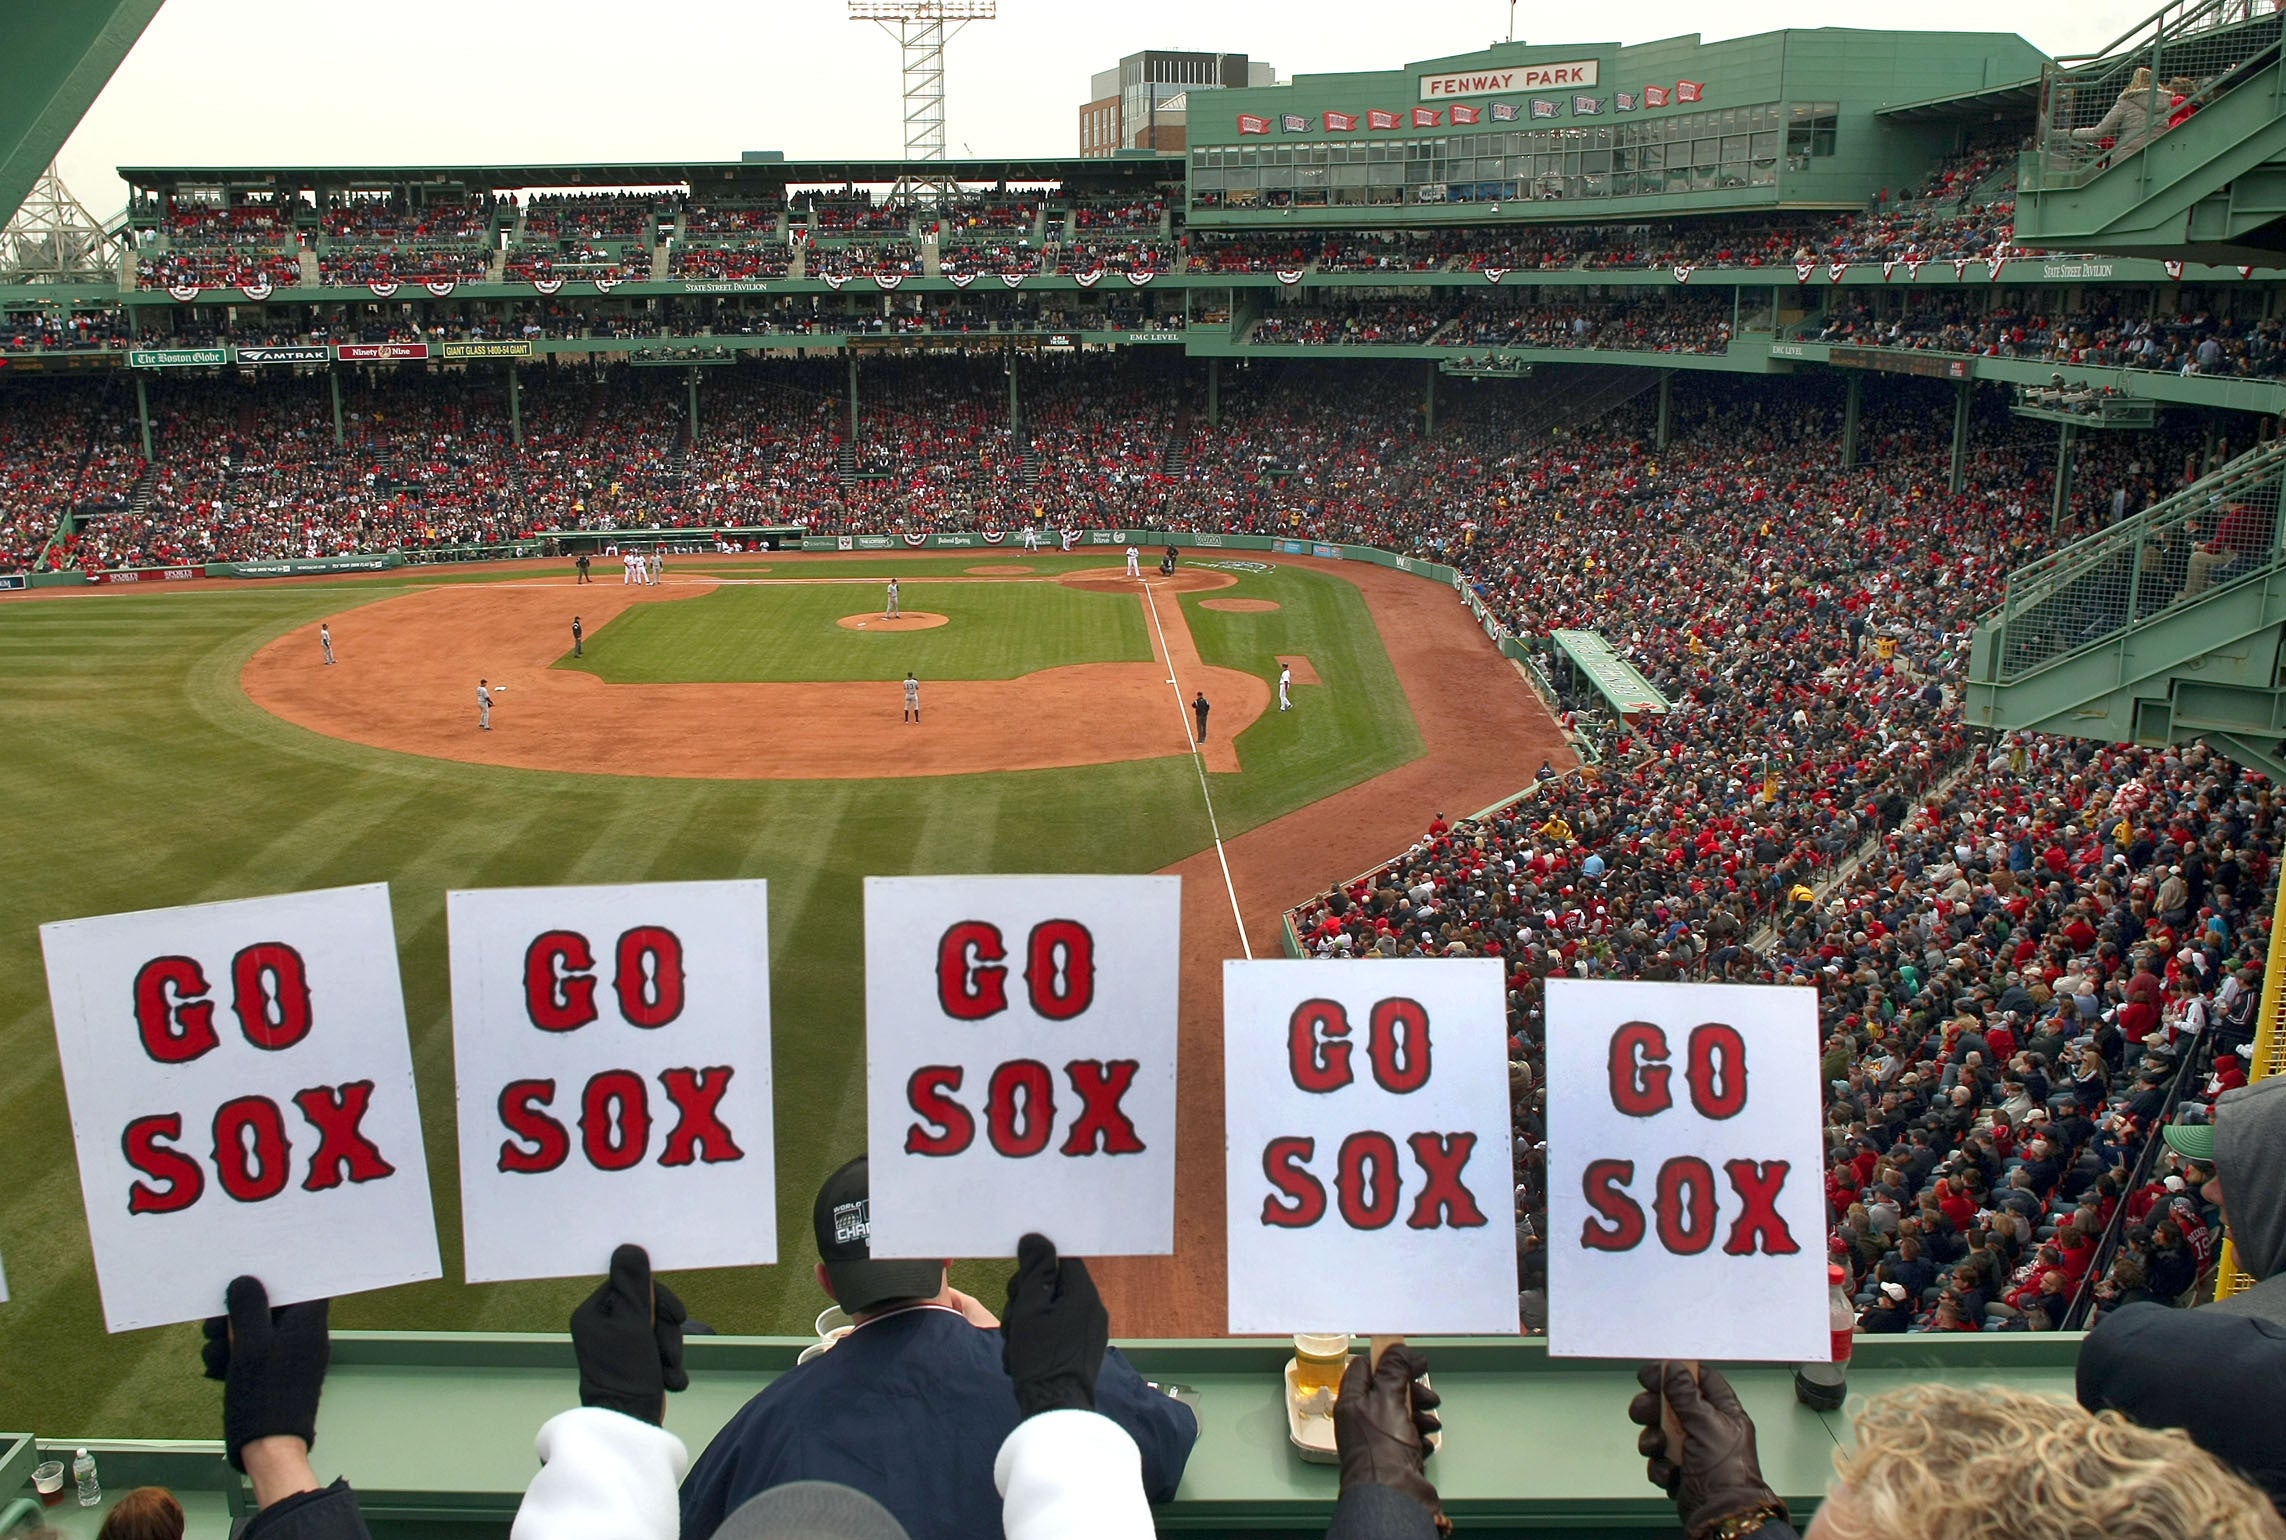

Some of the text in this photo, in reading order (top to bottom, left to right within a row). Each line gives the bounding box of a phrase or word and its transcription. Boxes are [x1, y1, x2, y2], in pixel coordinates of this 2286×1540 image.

[1431, 68, 1583, 95] FENWAY PARK
[2044, 263, 2112, 278] STATE STREET PAVILION
[707, 283, 731, 291] STREET
[733, 282, 767, 291] PAVILION
[138, 352, 220, 364] The Boston Globe
[263, 351, 324, 360] AMTRAK
[352, 348, 377, 357] Ninety
[446, 346, 464, 355] GIANT
[466, 346, 485, 355] GLASS
[510, 345, 527, 354] GIANT
[1773, 346, 1802, 355] EMC LEVEL
[109, 572, 138, 580] SPORTS
[164, 569, 192, 577] SPORTS
[523, 926, 685, 1033] GO
[936, 919, 1095, 1021] GO
[134, 942, 312, 1064] GO
[1288, 998, 1431, 1094] GO
[1608, 1022, 1747, 1120] GO
[497, 1066, 744, 1174] SOX
[904, 1059, 1146, 1158] SOX
[121, 1080, 395, 1215] SOX
[1261, 1131, 1488, 1230] SOX
[834, 1201, 862, 1212] WORLD
[1581, 1156, 1800, 1256] SOX
[2195, 1237, 2210, 1260] 19
